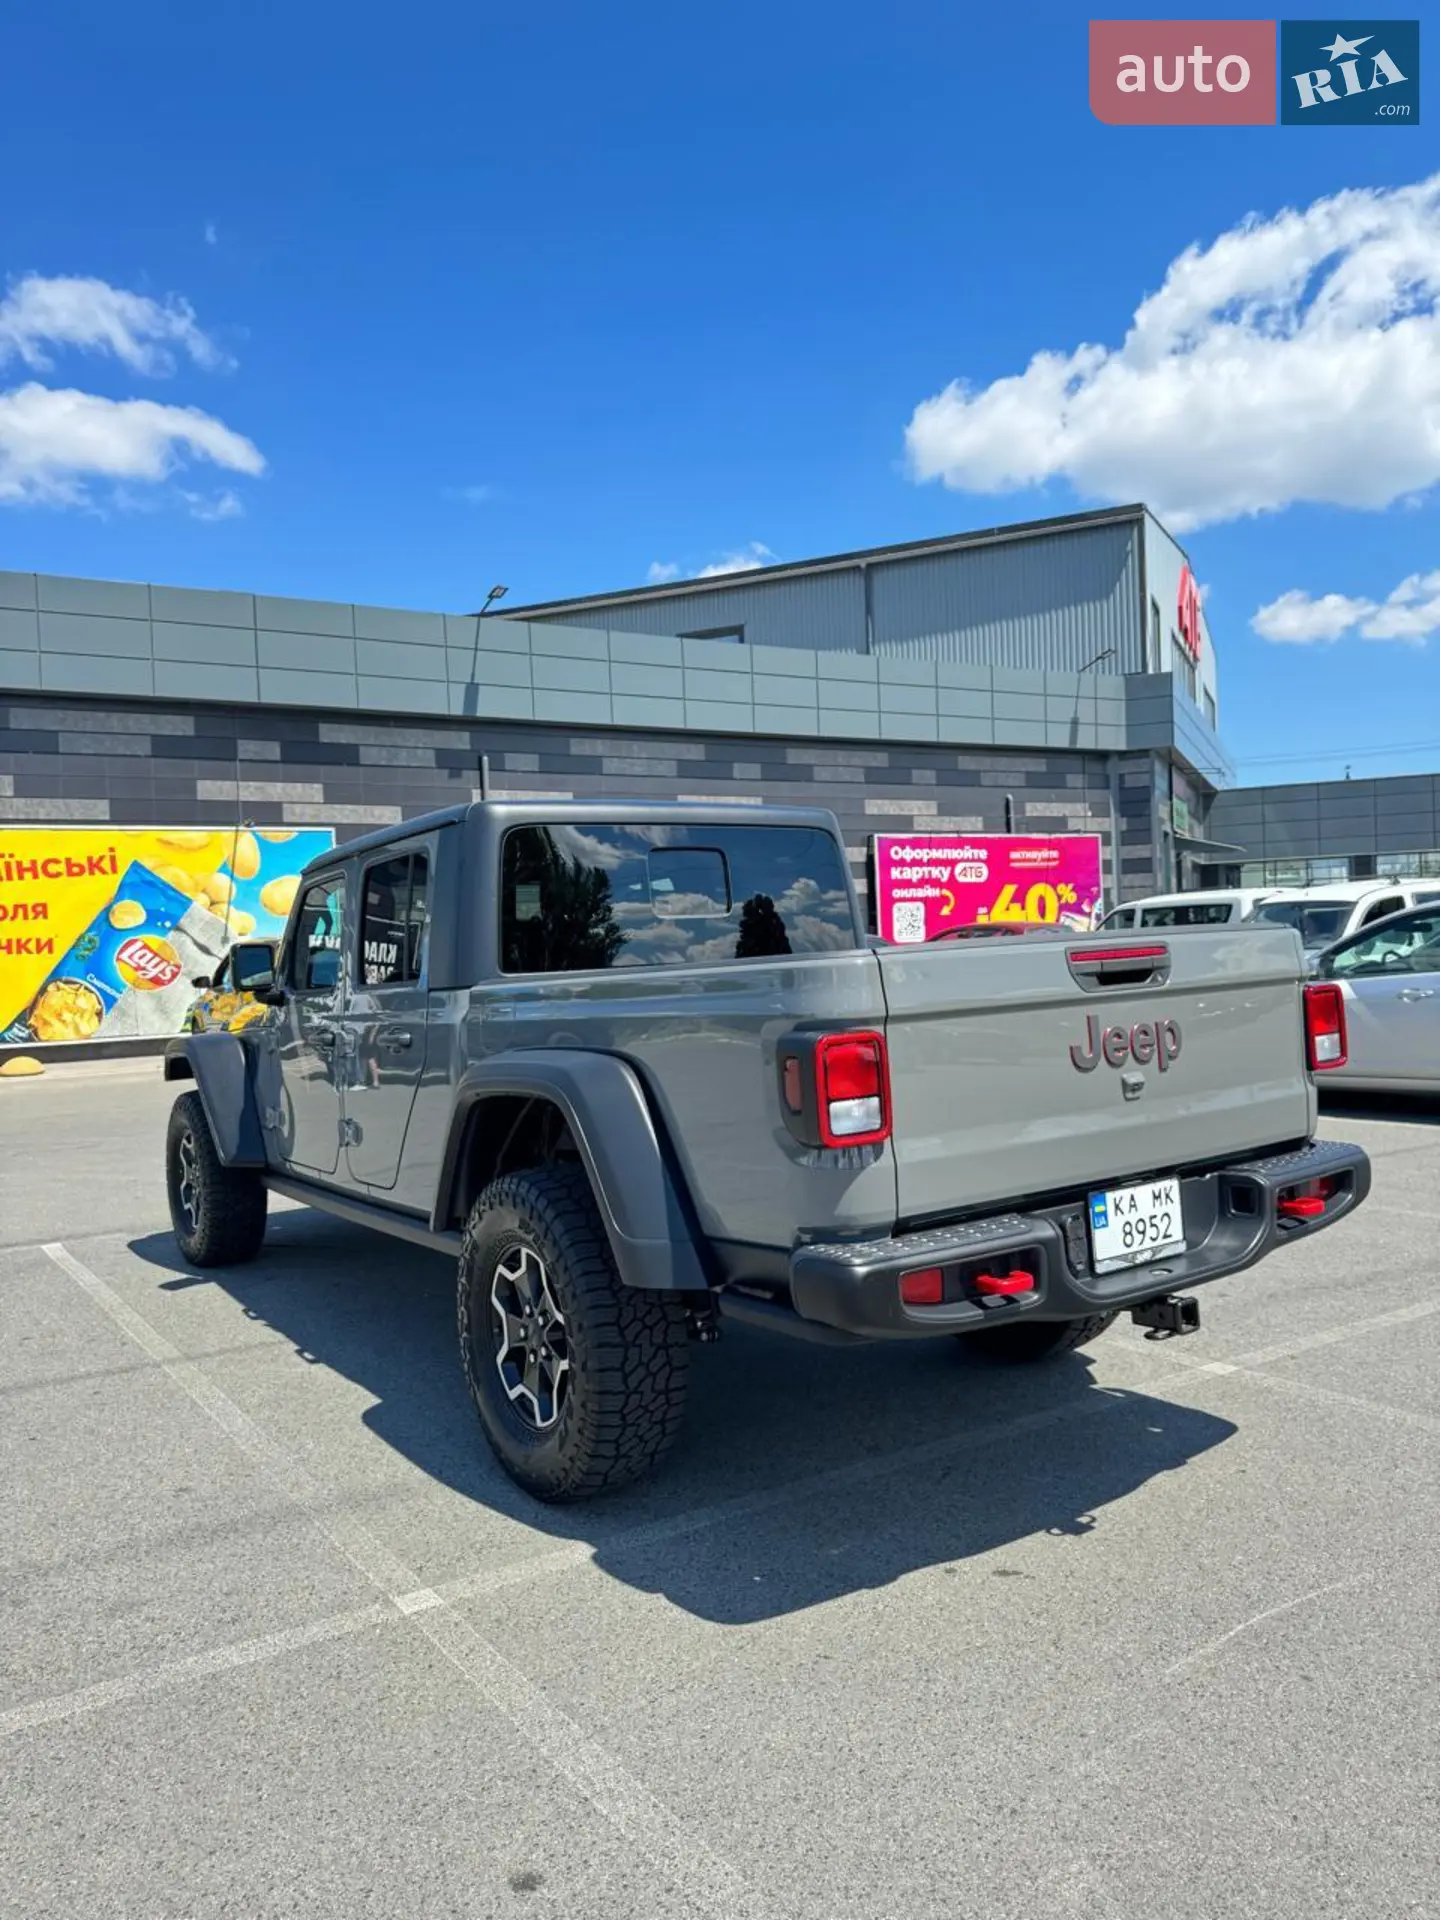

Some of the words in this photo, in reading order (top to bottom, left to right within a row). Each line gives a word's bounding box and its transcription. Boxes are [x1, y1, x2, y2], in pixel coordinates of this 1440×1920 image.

[0, 847, 118, 881] їнські
[890, 845, 988, 863] Оформлюйте
[890, 866, 952, 883] картку
[892, 885, 941, 898] онлайн
[1069, 1014, 1182, 1074] Jeep
[1113, 1193, 1138, 1216] KA
[1122, 1212, 1173, 1248] 8952
